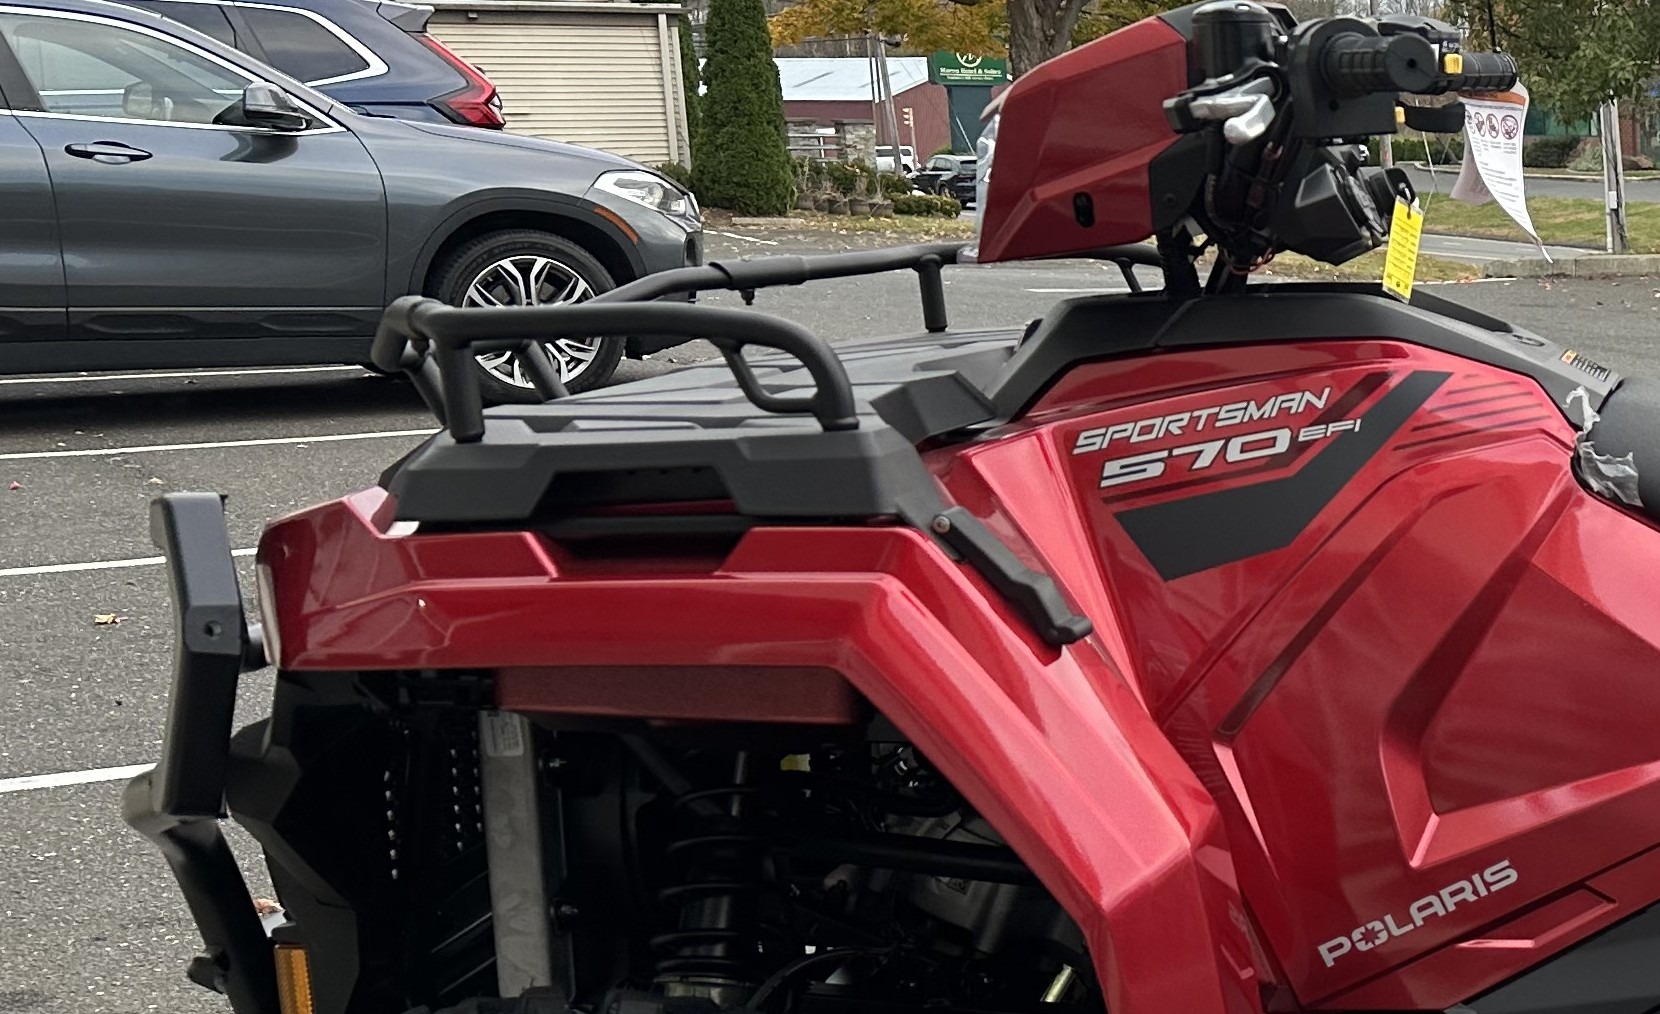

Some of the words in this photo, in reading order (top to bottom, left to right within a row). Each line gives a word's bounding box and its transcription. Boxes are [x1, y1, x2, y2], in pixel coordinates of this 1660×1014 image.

[1072, 387, 1332, 455] SPORTSMAN
[1100, 427, 1293, 488] 570
[1297, 418, 1362, 442] EFI
[1317, 859, 1519, 968] POLARIS
